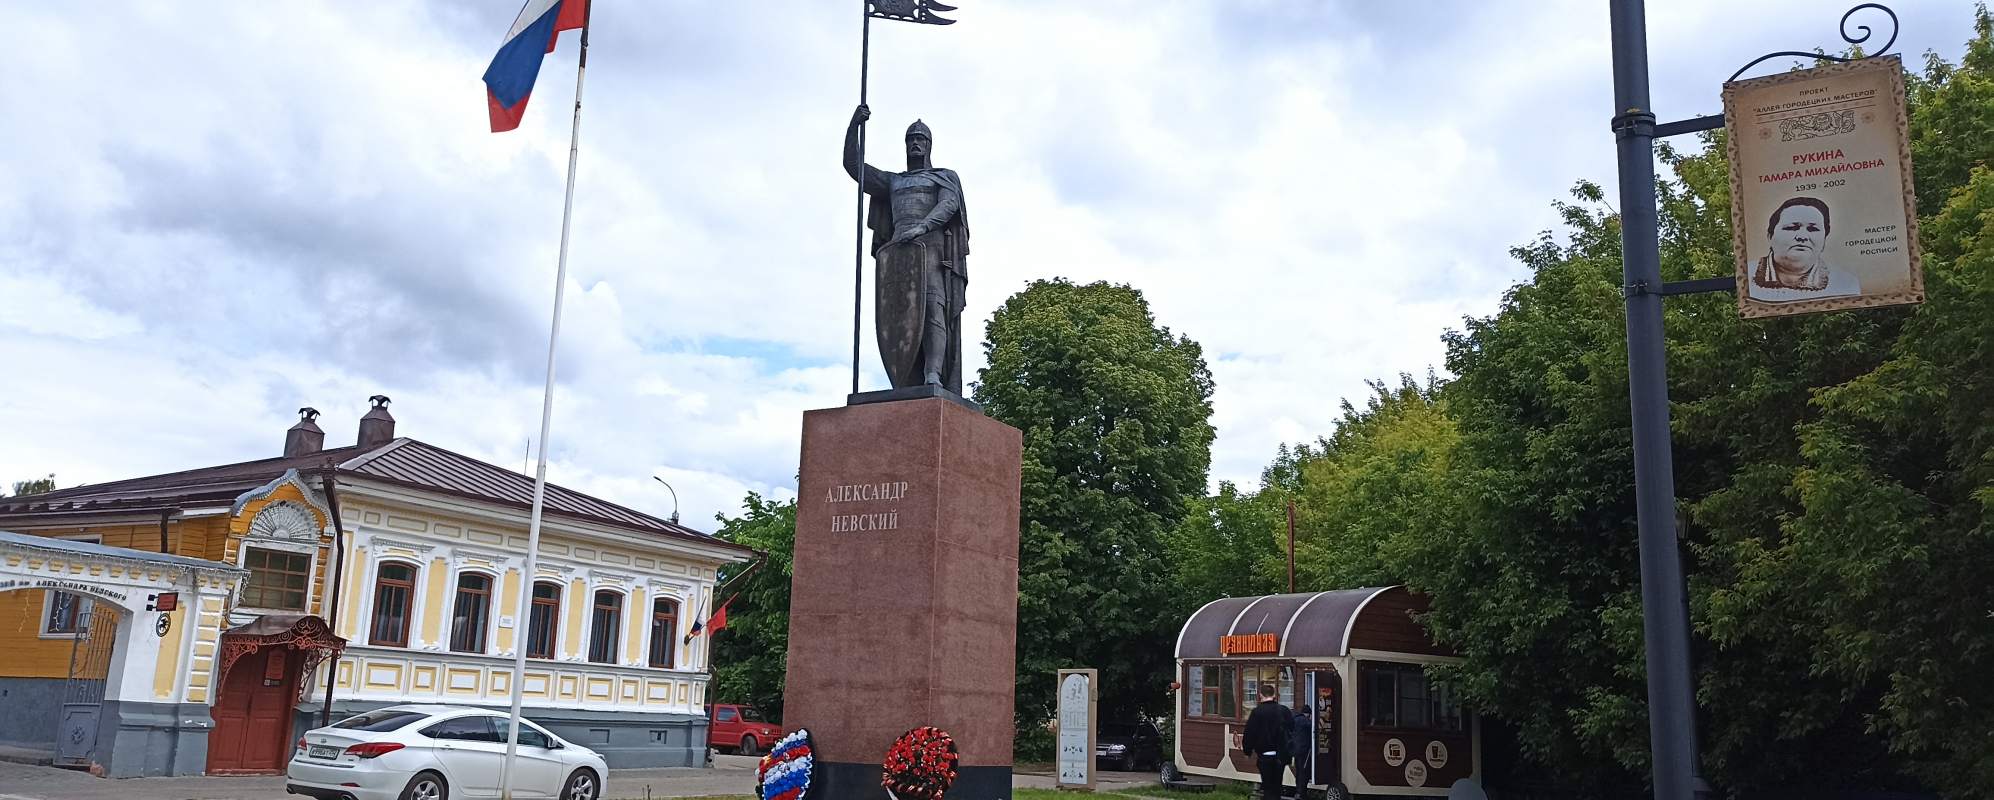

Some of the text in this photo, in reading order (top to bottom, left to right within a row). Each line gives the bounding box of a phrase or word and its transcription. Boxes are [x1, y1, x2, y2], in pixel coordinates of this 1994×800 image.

[1800, 87, 1828, 96] ПРОЕКТ
[1782, 98, 1831, 109] ГОРОДЕЦКИХ
[1792, 149, 1845, 164] РУКИНА
[1758, 159, 1885, 183] ТАМАРА МИХАЙЛОВНА
[1795, 183, 1817, 192] 1939
[1823, 179, 1846, 188] 2002
[1864, 224, 1896, 233] МАСТЕР
[1860, 246, 1898, 255] РОСПИСИ
[824, 481, 909, 503] АЛЕКСАНДР
[831, 508, 899, 533] НЕВСКИЙ
